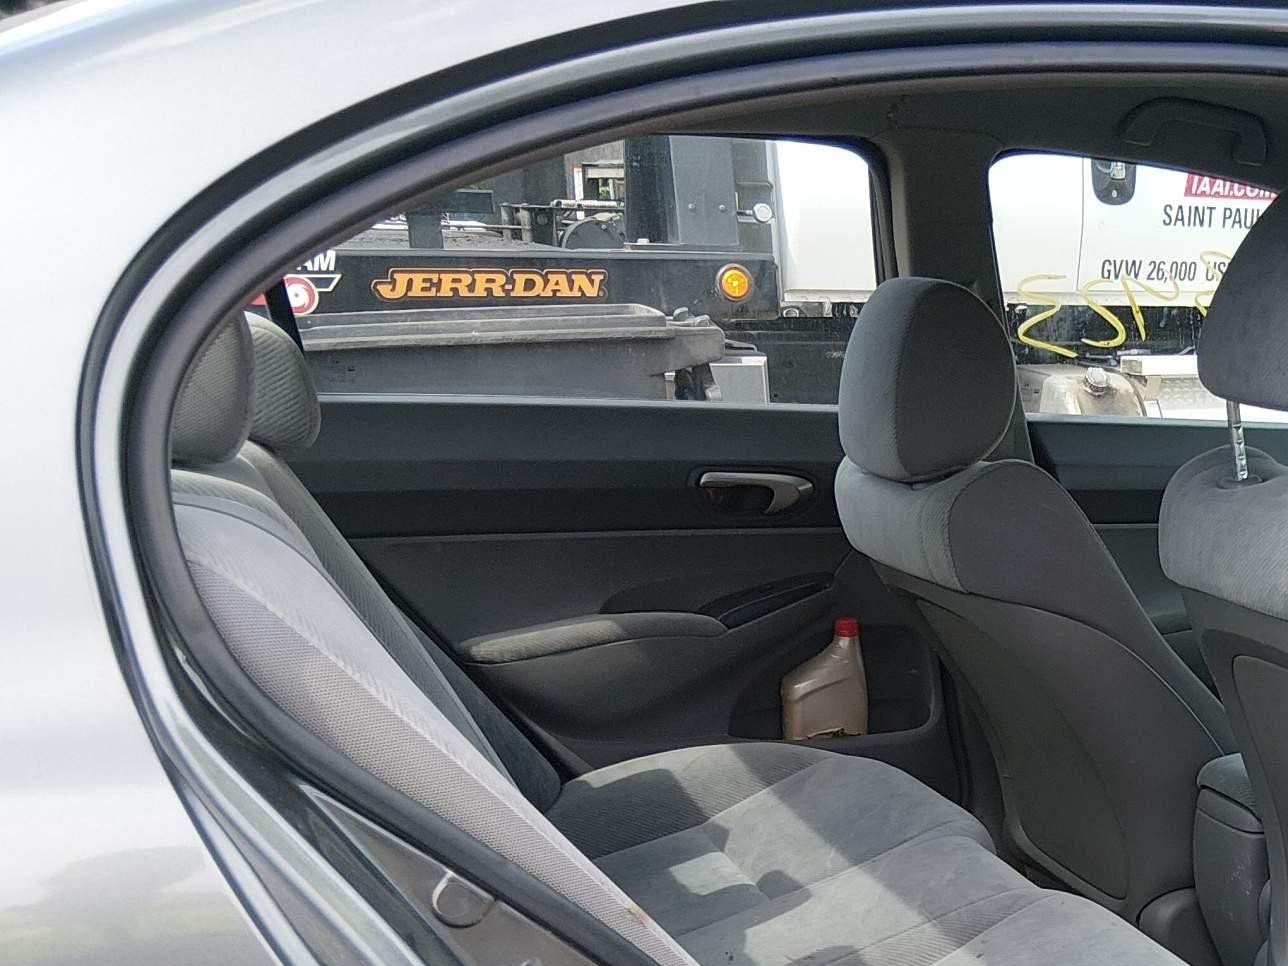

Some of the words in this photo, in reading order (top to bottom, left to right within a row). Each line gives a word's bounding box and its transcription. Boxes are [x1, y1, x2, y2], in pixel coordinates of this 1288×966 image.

[1163, 204, 1216, 228] SAINT
[1101, 259, 1142, 281] GVW
[1146, 260, 1197, 283] 26,000
[1205, 261, 1231, 282] US
[376, 272, 604, 300] JERR-DAN
